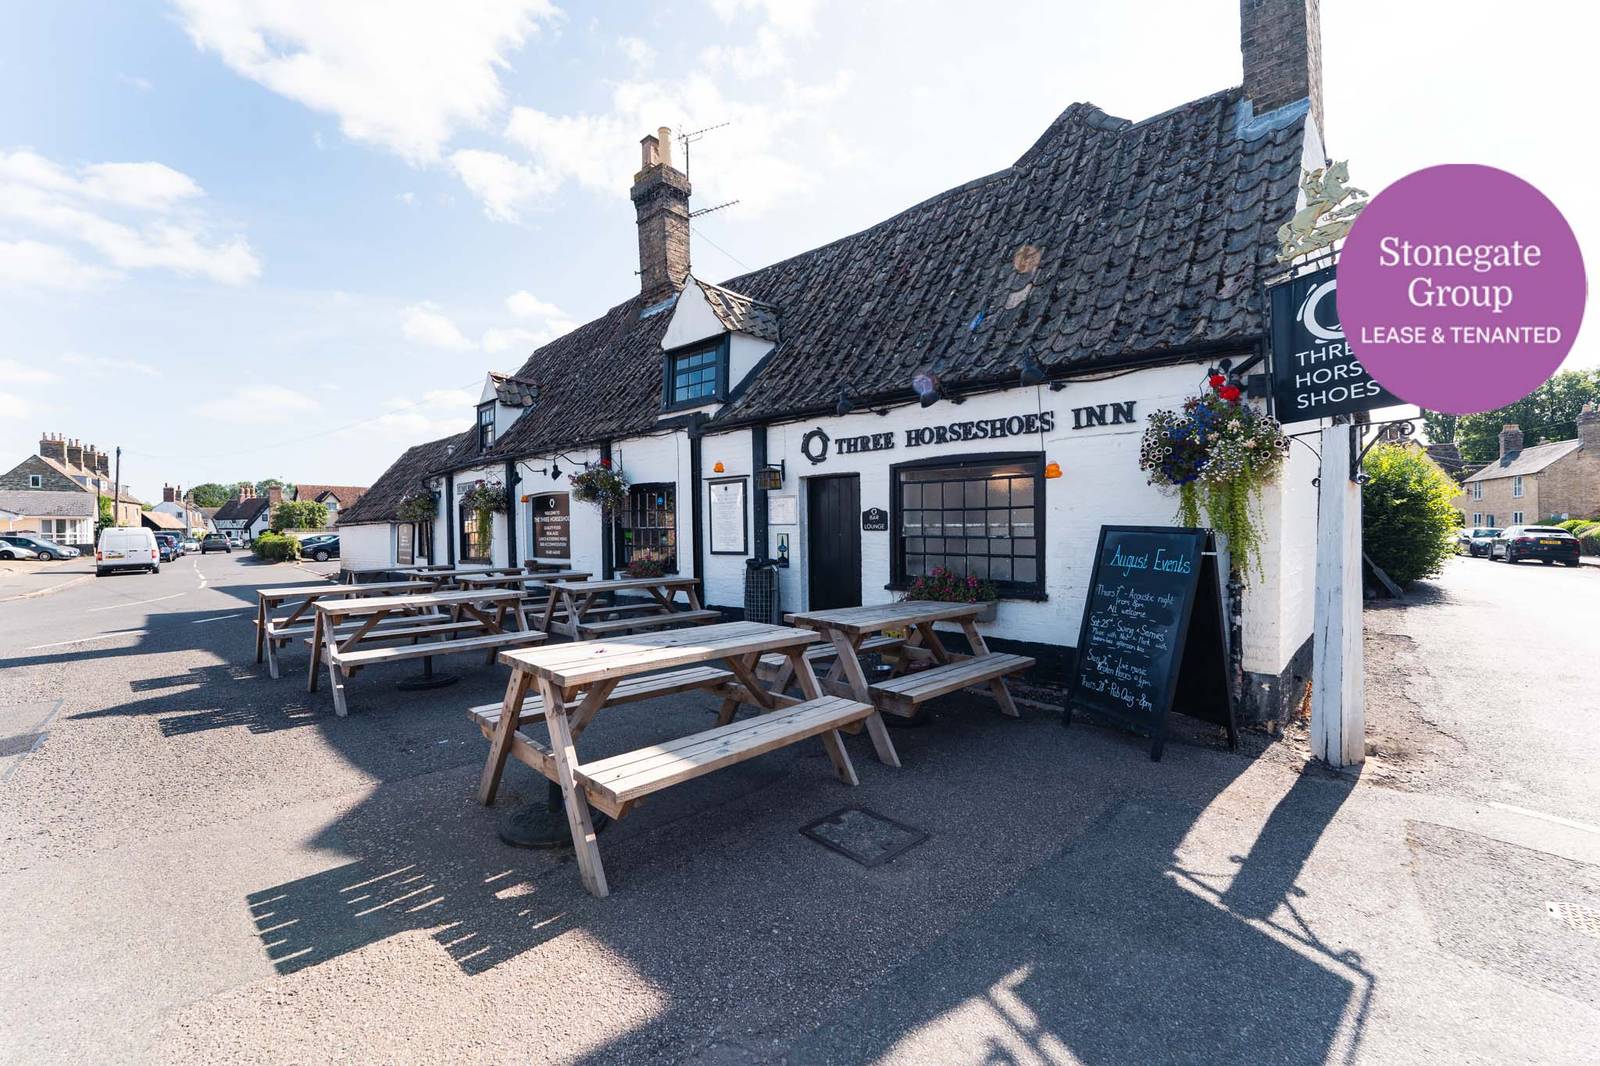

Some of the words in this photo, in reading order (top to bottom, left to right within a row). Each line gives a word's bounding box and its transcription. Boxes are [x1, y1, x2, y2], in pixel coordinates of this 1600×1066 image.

[1295, 341, 1354, 366] THRE
[1296, 360, 1364, 388] HORS
[1297, 380, 1381, 409] SHOES
[835, 431, 895, 455] THREE
[905, 410, 1054, 448] HORSESHOES
[1071, 400, 1137, 430] INN
[1110, 544, 1148, 577] August
[1154, 548, 1191, 574] Events
